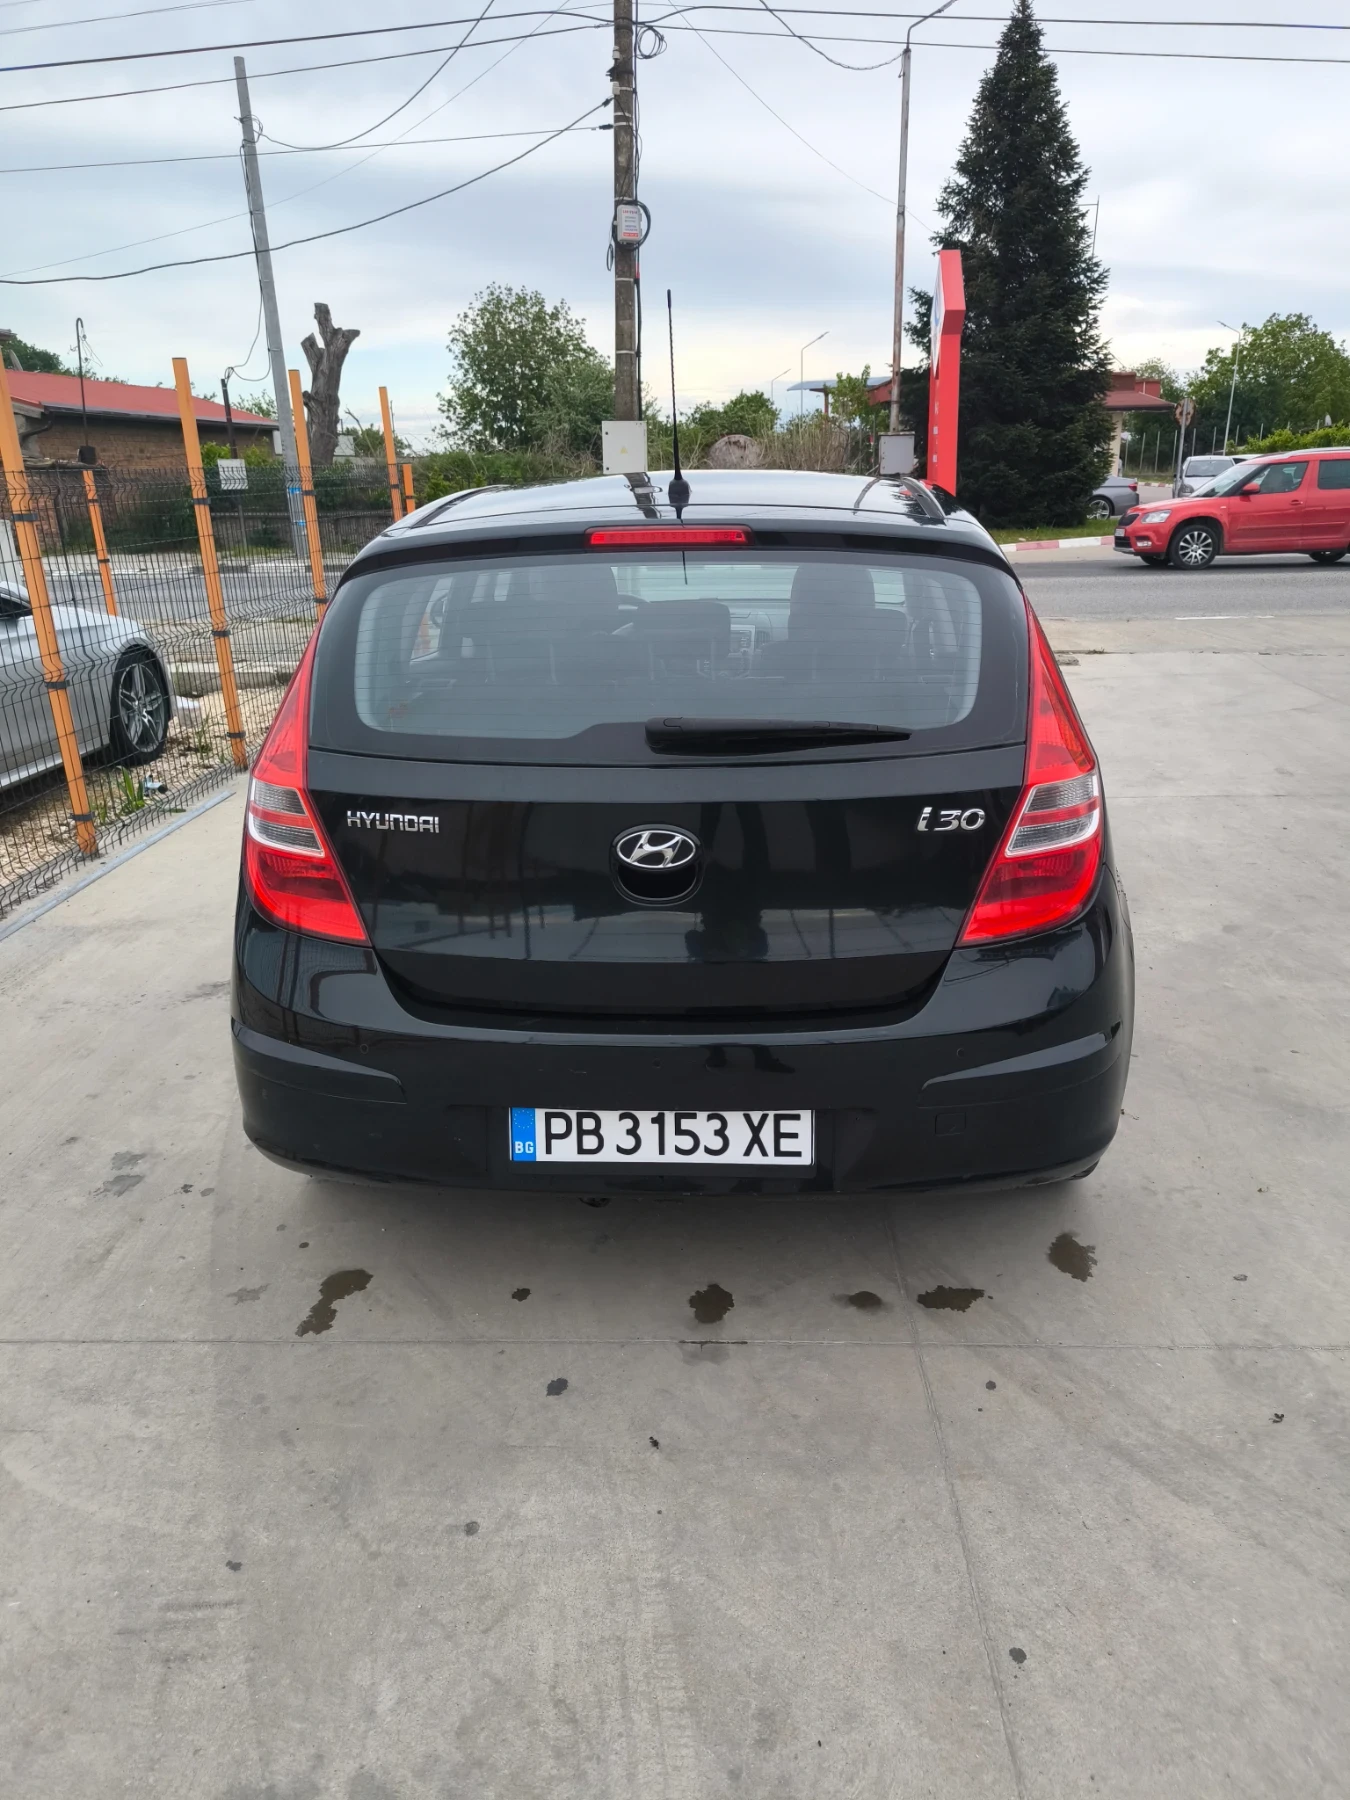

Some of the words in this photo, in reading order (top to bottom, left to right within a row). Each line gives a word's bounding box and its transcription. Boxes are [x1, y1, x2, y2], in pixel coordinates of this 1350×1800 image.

[346, 810, 440, 834] HYUNDAI
[544, 1111, 605, 1156] PB
[615, 1111, 730, 1157] 3153
[742, 1112, 803, 1158] XE
[514, 1141, 535, 1154] BG
